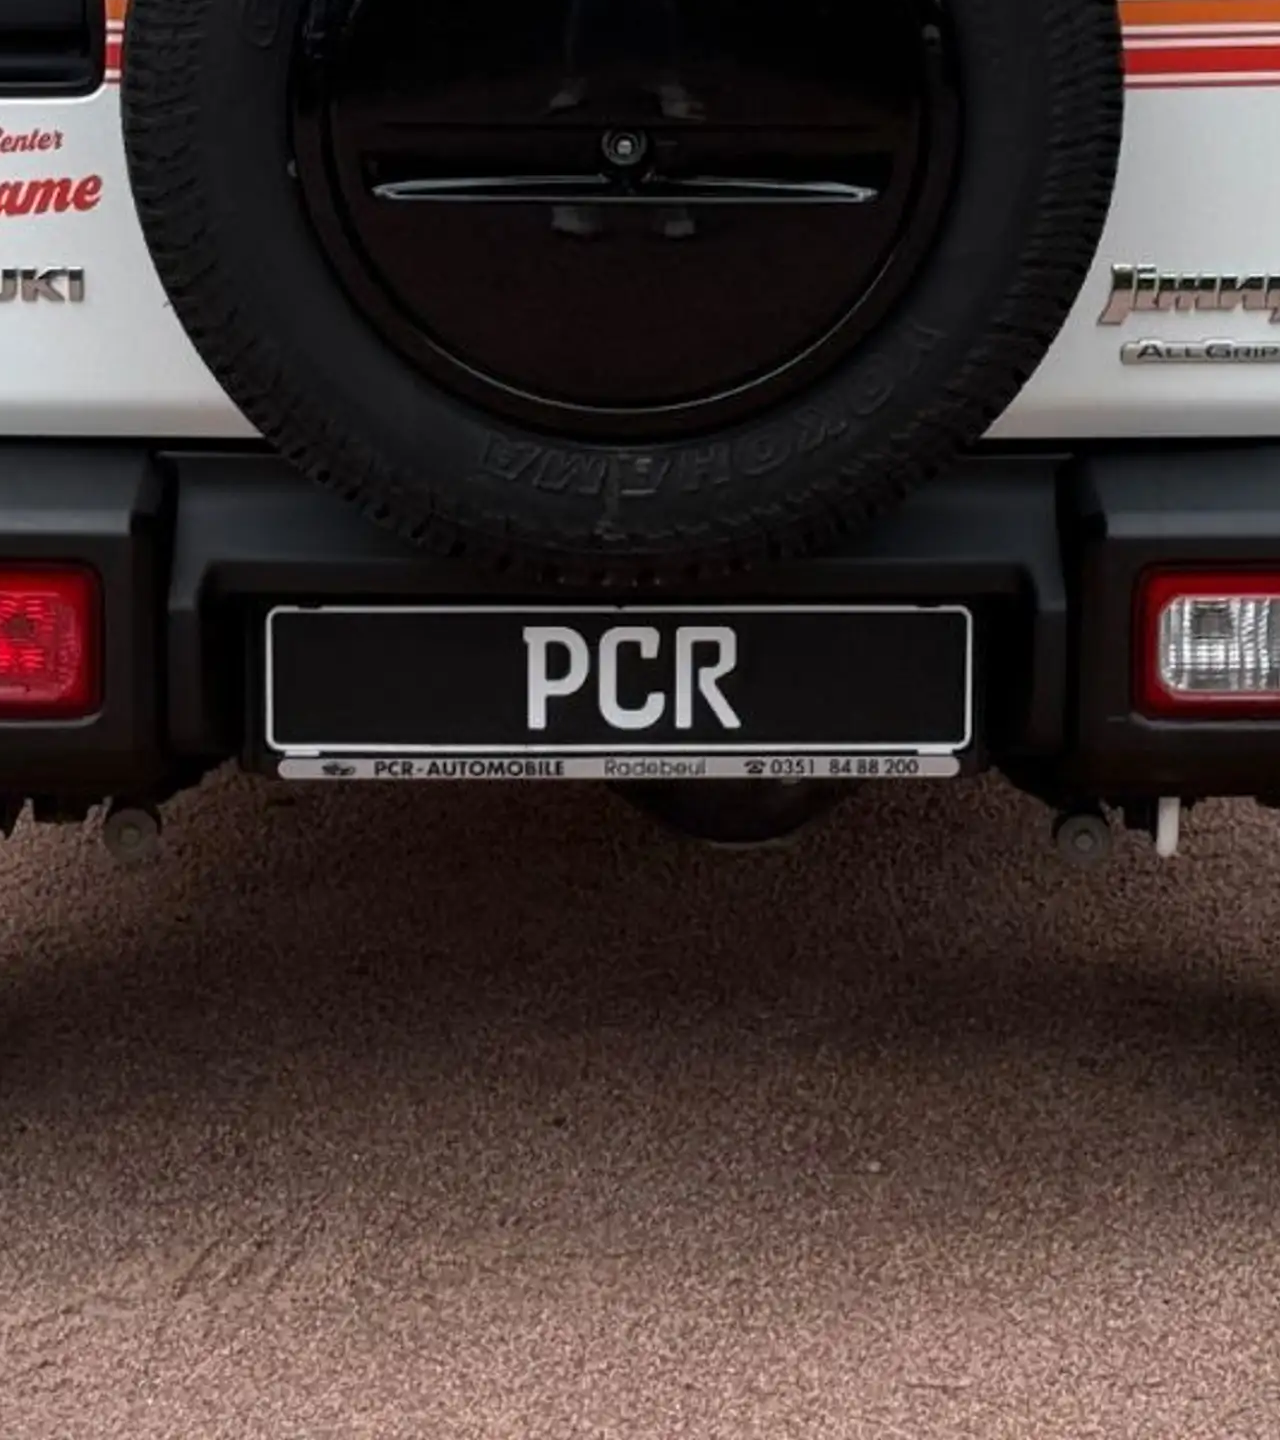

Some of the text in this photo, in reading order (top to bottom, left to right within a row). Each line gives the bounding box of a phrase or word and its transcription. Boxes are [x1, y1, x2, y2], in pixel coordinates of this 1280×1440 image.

[522, 626, 742, 731] PCR
[373, 760, 565, 777] PCR-AUTOMOBILE
[603, 758, 707, 776] Radebeul
[884, 759, 920, 775] 200
